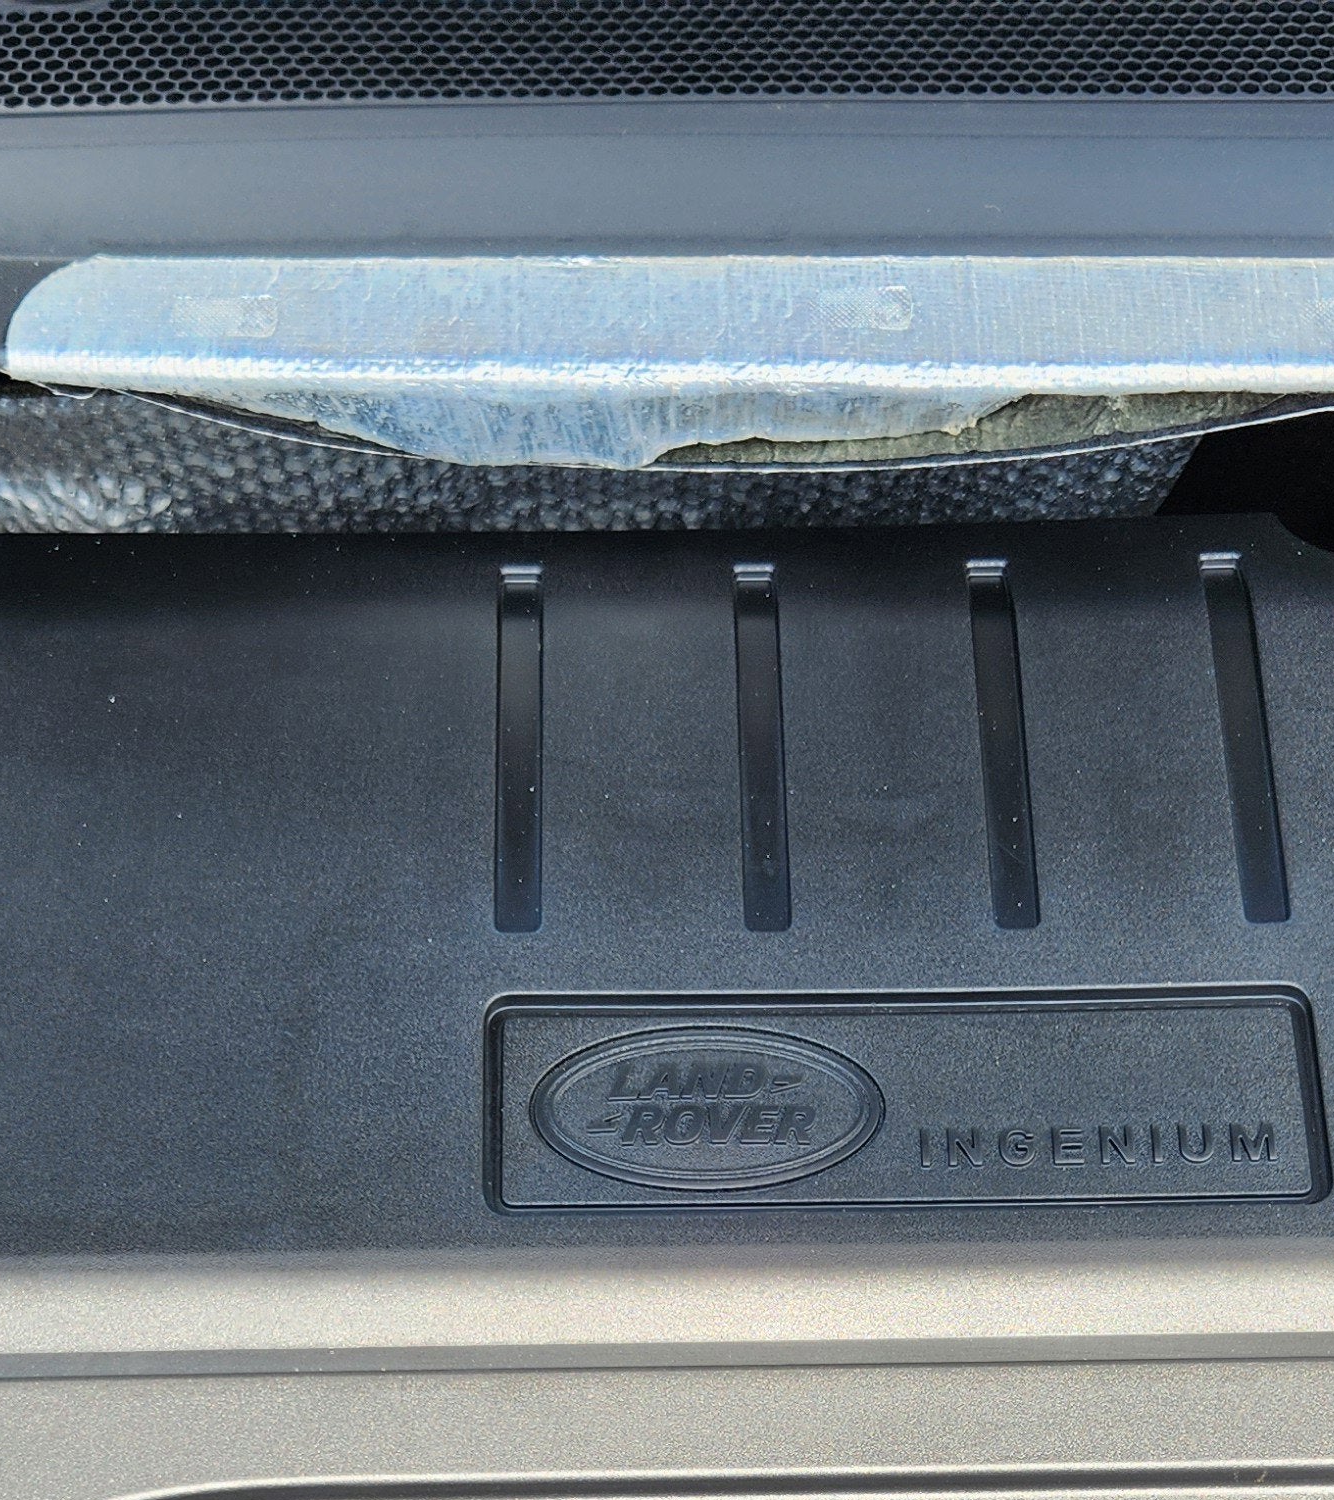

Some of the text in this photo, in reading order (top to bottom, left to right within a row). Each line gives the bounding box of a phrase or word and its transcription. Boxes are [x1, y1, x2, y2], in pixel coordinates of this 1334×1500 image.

[606, 1061, 771, 1102] LAND
[619, 1104, 817, 1147] ROVER
[919, 1122, 1280, 1169] INGENIUM
